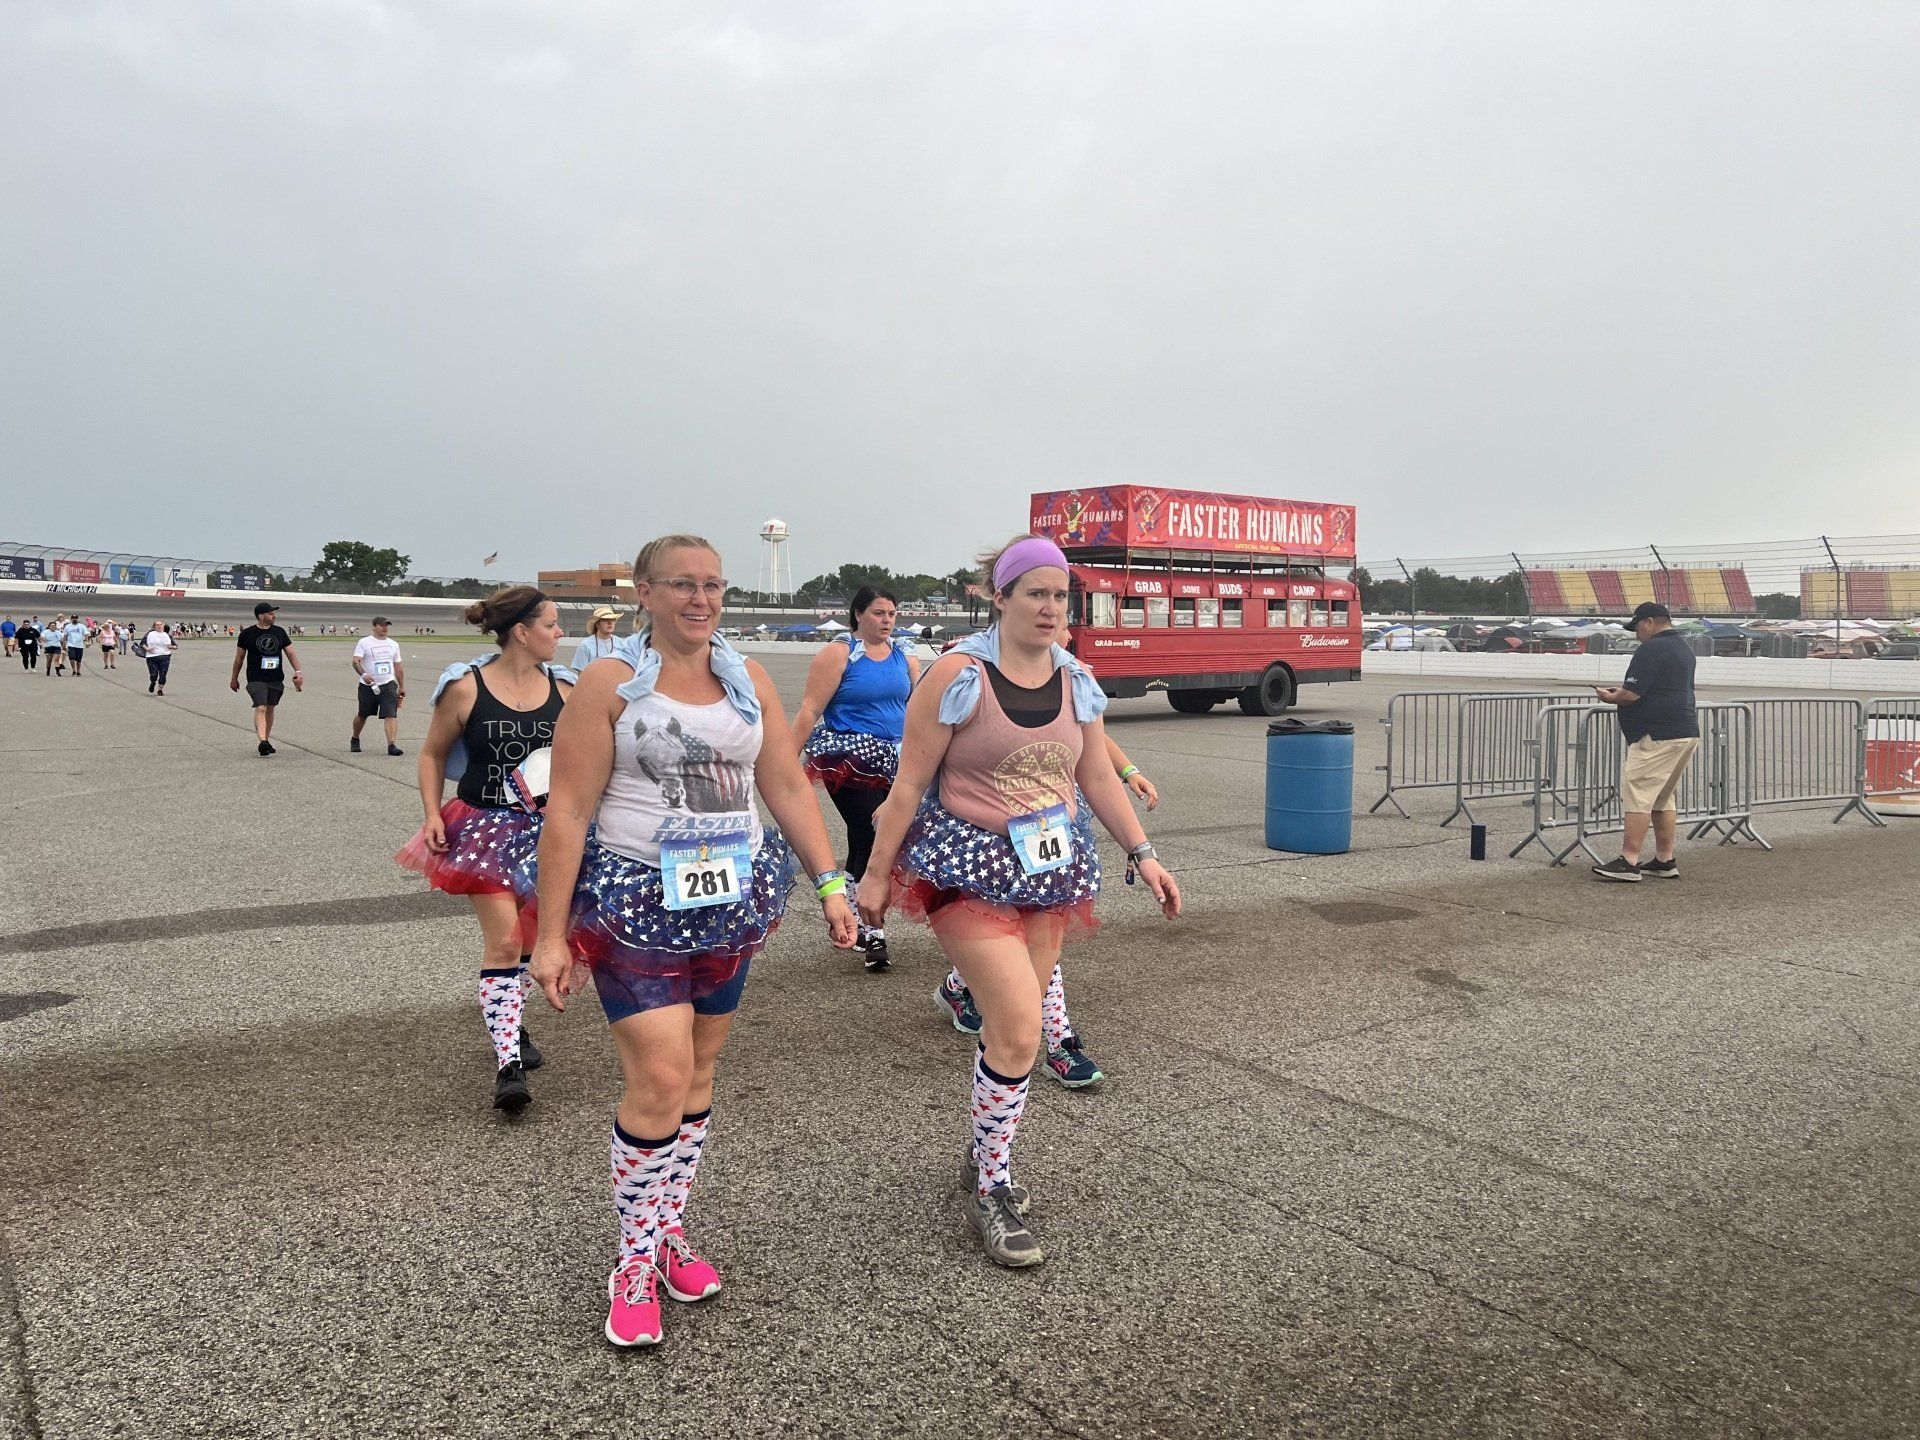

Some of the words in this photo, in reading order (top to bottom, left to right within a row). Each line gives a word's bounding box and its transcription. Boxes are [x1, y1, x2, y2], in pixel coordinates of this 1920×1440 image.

[1033, 513, 1062, 528] FASTER
[1082, 509, 1124, 523] HUMANS
[1168, 501, 1240, 540] FASTER
[1246, 508, 1323, 545] HUMANS
[1135, 581, 1162, 593] GRAB
[1182, 585, 1201, 594] SOME
[1218, 583, 1243, 595] BUDS
[1263, 587, 1275, 595] AND
[1293, 585, 1316, 597] CAMP
[1300, 633, 1350, 648] Budweiser
[1145, 679, 1170, 688] GOODYEAR
[1020, 748, 1031, 757] OF
[1034, 743, 1052, 752] THE
[1000, 778, 1037, 791] FASTER
[1015, 822, 1038, 832] FASTER
[669, 849, 697, 858] FASTER
[1039, 836, 1062, 861] 44
[684, 868, 730, 898] 281
